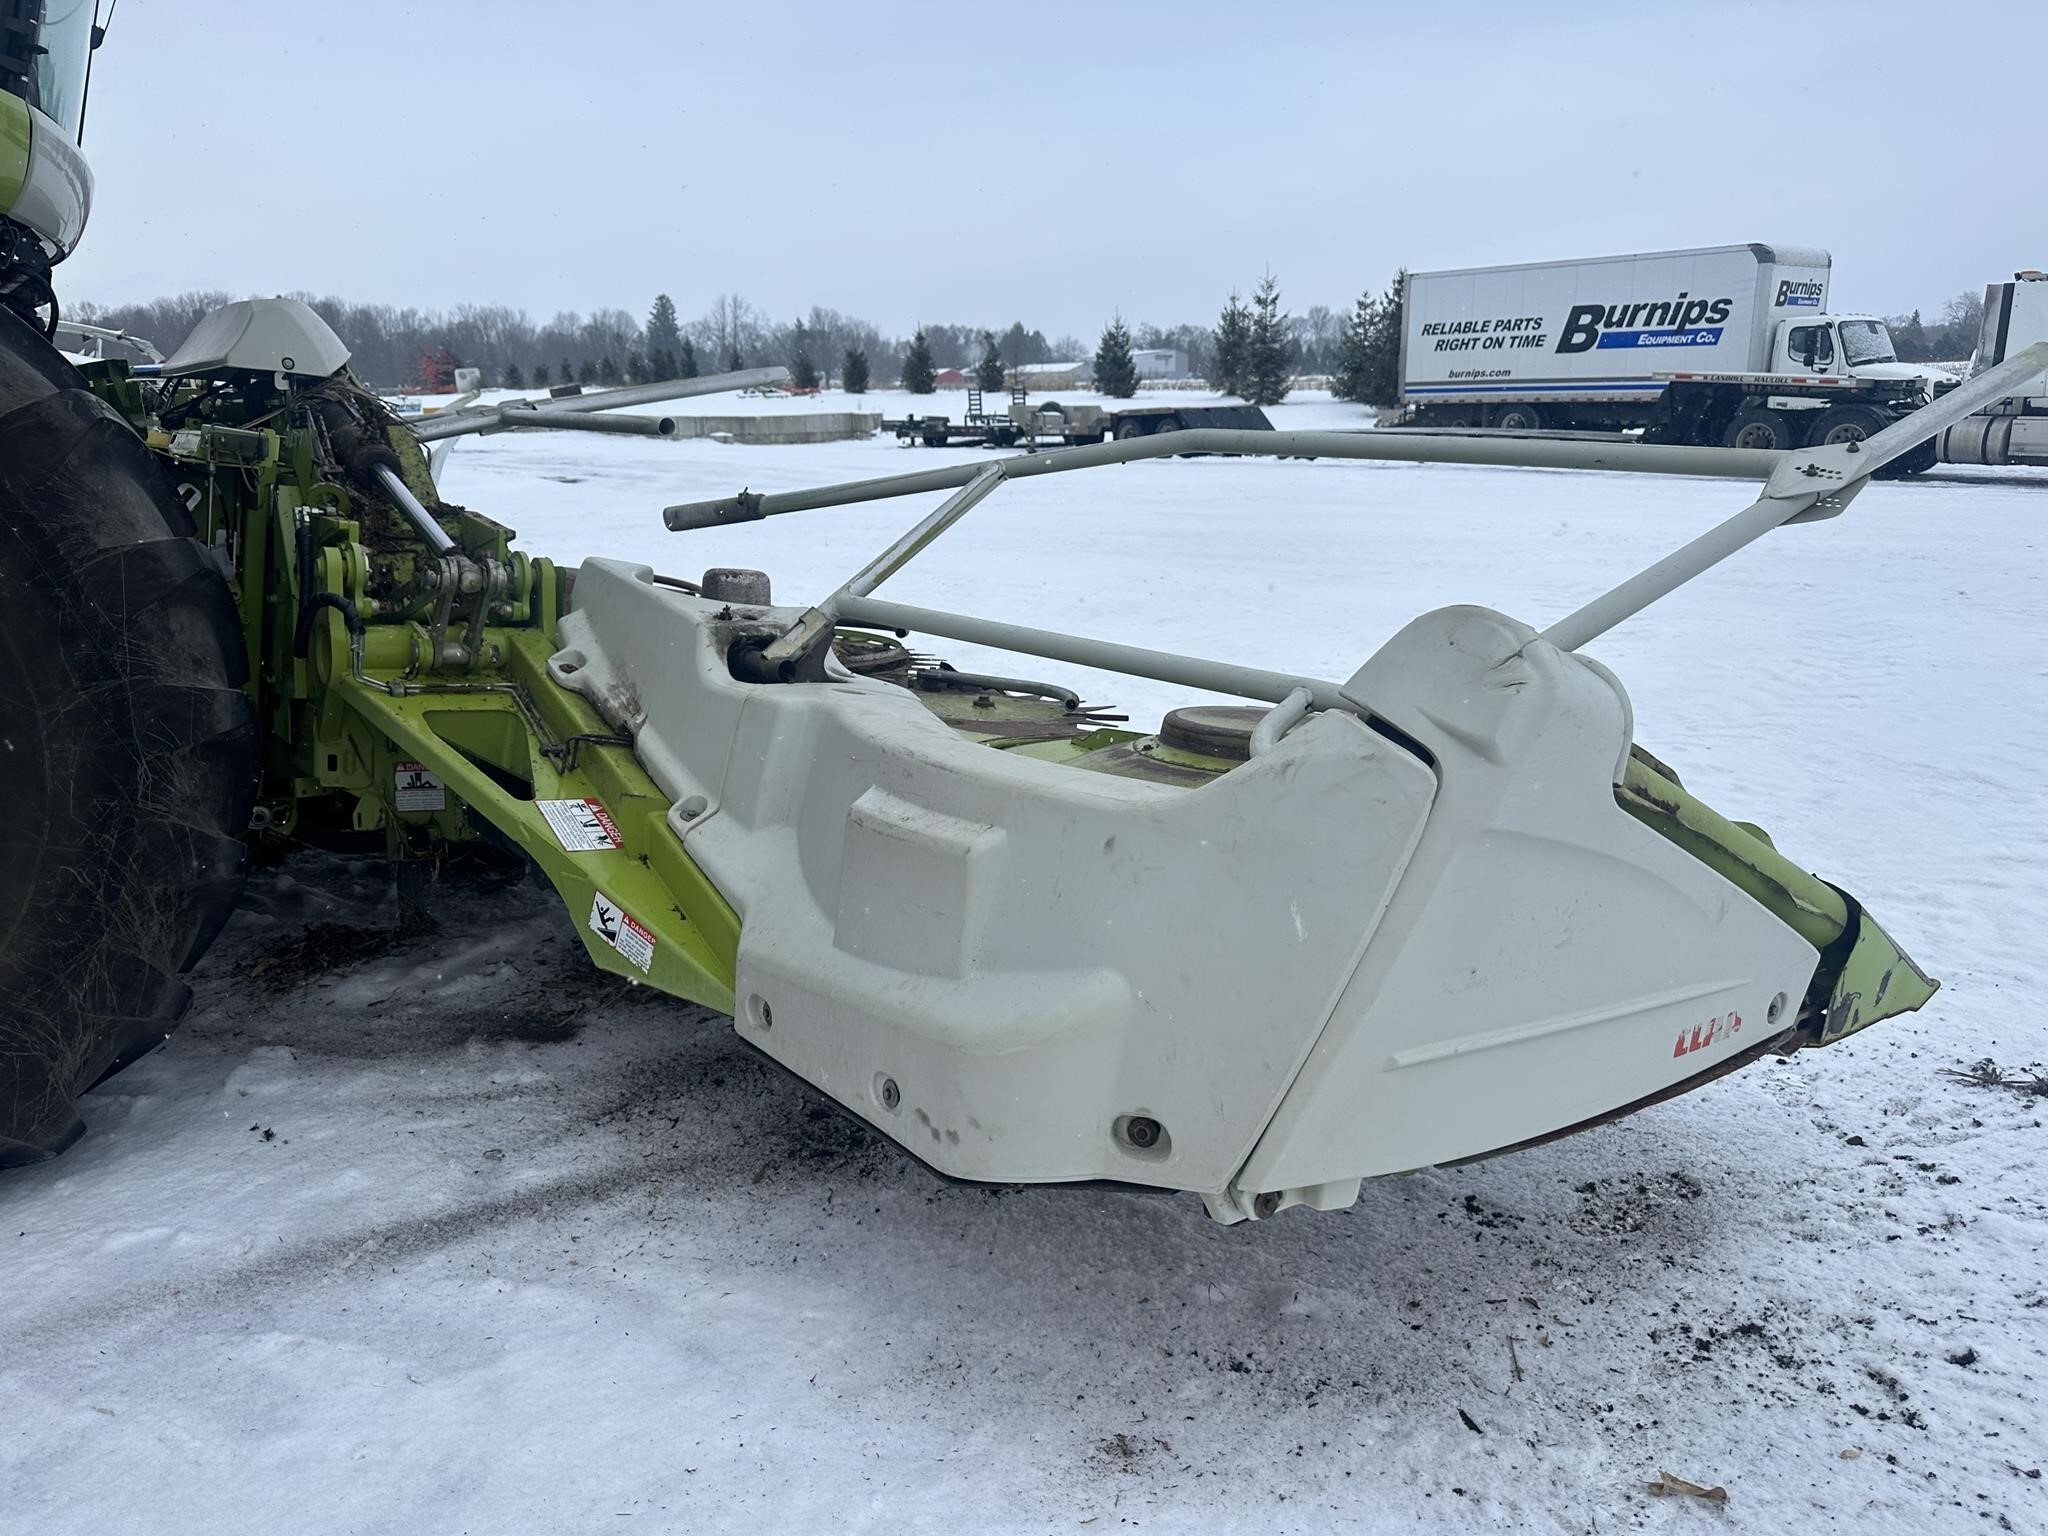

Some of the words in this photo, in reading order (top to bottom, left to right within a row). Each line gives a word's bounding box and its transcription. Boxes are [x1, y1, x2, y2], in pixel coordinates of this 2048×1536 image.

[1775, 278, 1823, 307] Burnips
[1421, 320, 1491, 336] RELIABLE
[1493, 317, 1543, 333] PARTS
[1554, 292, 1733, 354] Burnips
[1434, 337, 1481, 352] RIGHT
[1482, 336, 1505, 350] ON
[1509, 334, 1547, 349] TIME
[1637, 333, 1694, 345] EQUIPMENT
[1448, 369, 1511, 380] burnips.com
